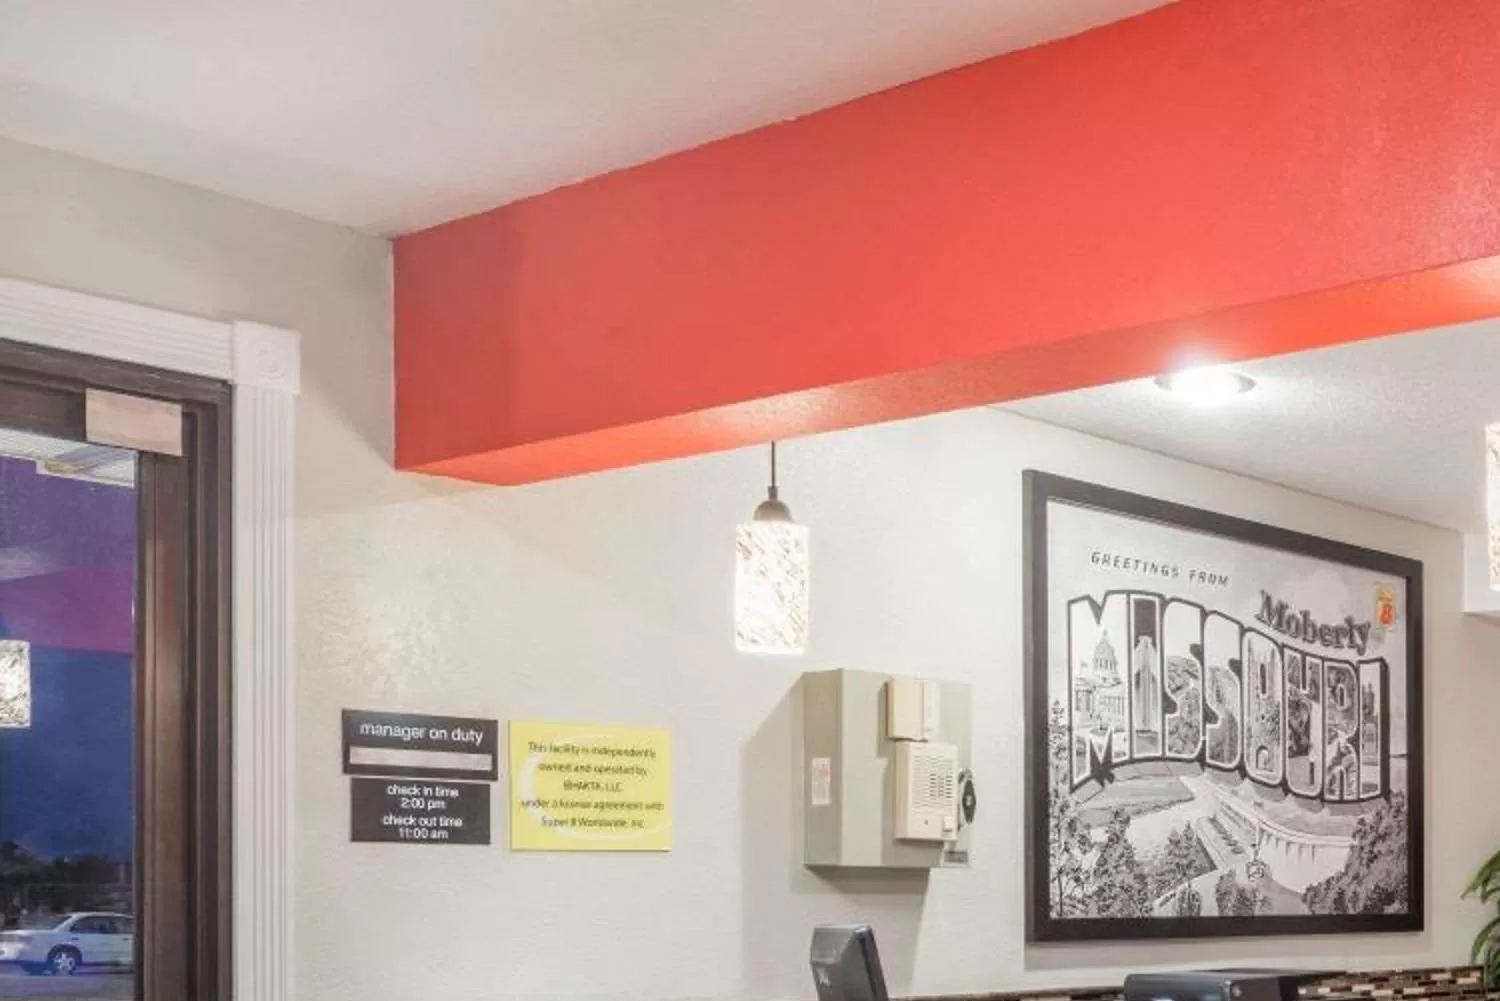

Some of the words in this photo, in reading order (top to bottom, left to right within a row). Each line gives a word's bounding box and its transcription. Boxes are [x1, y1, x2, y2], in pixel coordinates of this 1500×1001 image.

[1091, 551, 1181, 578] GREETINGS
[1188, 569, 1229, 587] FROM
[1253, 589, 1371, 656] Moberly
[1067, 589, 1390, 802] MISSOURI
[360, 722, 427, 741] manager
[429, 727, 448, 740] on
[451, 727, 483, 746] duty
[528, 741, 546, 752] This
[550, 742, 579, 756] facility
[591, 745, 657, 758] independently
[538, 763, 571, 774] owned
[574, 763, 591, 774] and
[386, 783, 421, 797] check
[423, 785, 433, 796] in
[435, 785, 459, 798] time
[400, 797, 425, 809] 2:00
[427, 799, 446, 811] pm
[382, 813, 416, 826] check
[418, 815, 437, 827] out
[439, 816, 463, 828] time
[399, 827, 428, 839] 11:00
[430, 829, 449, 840] am
